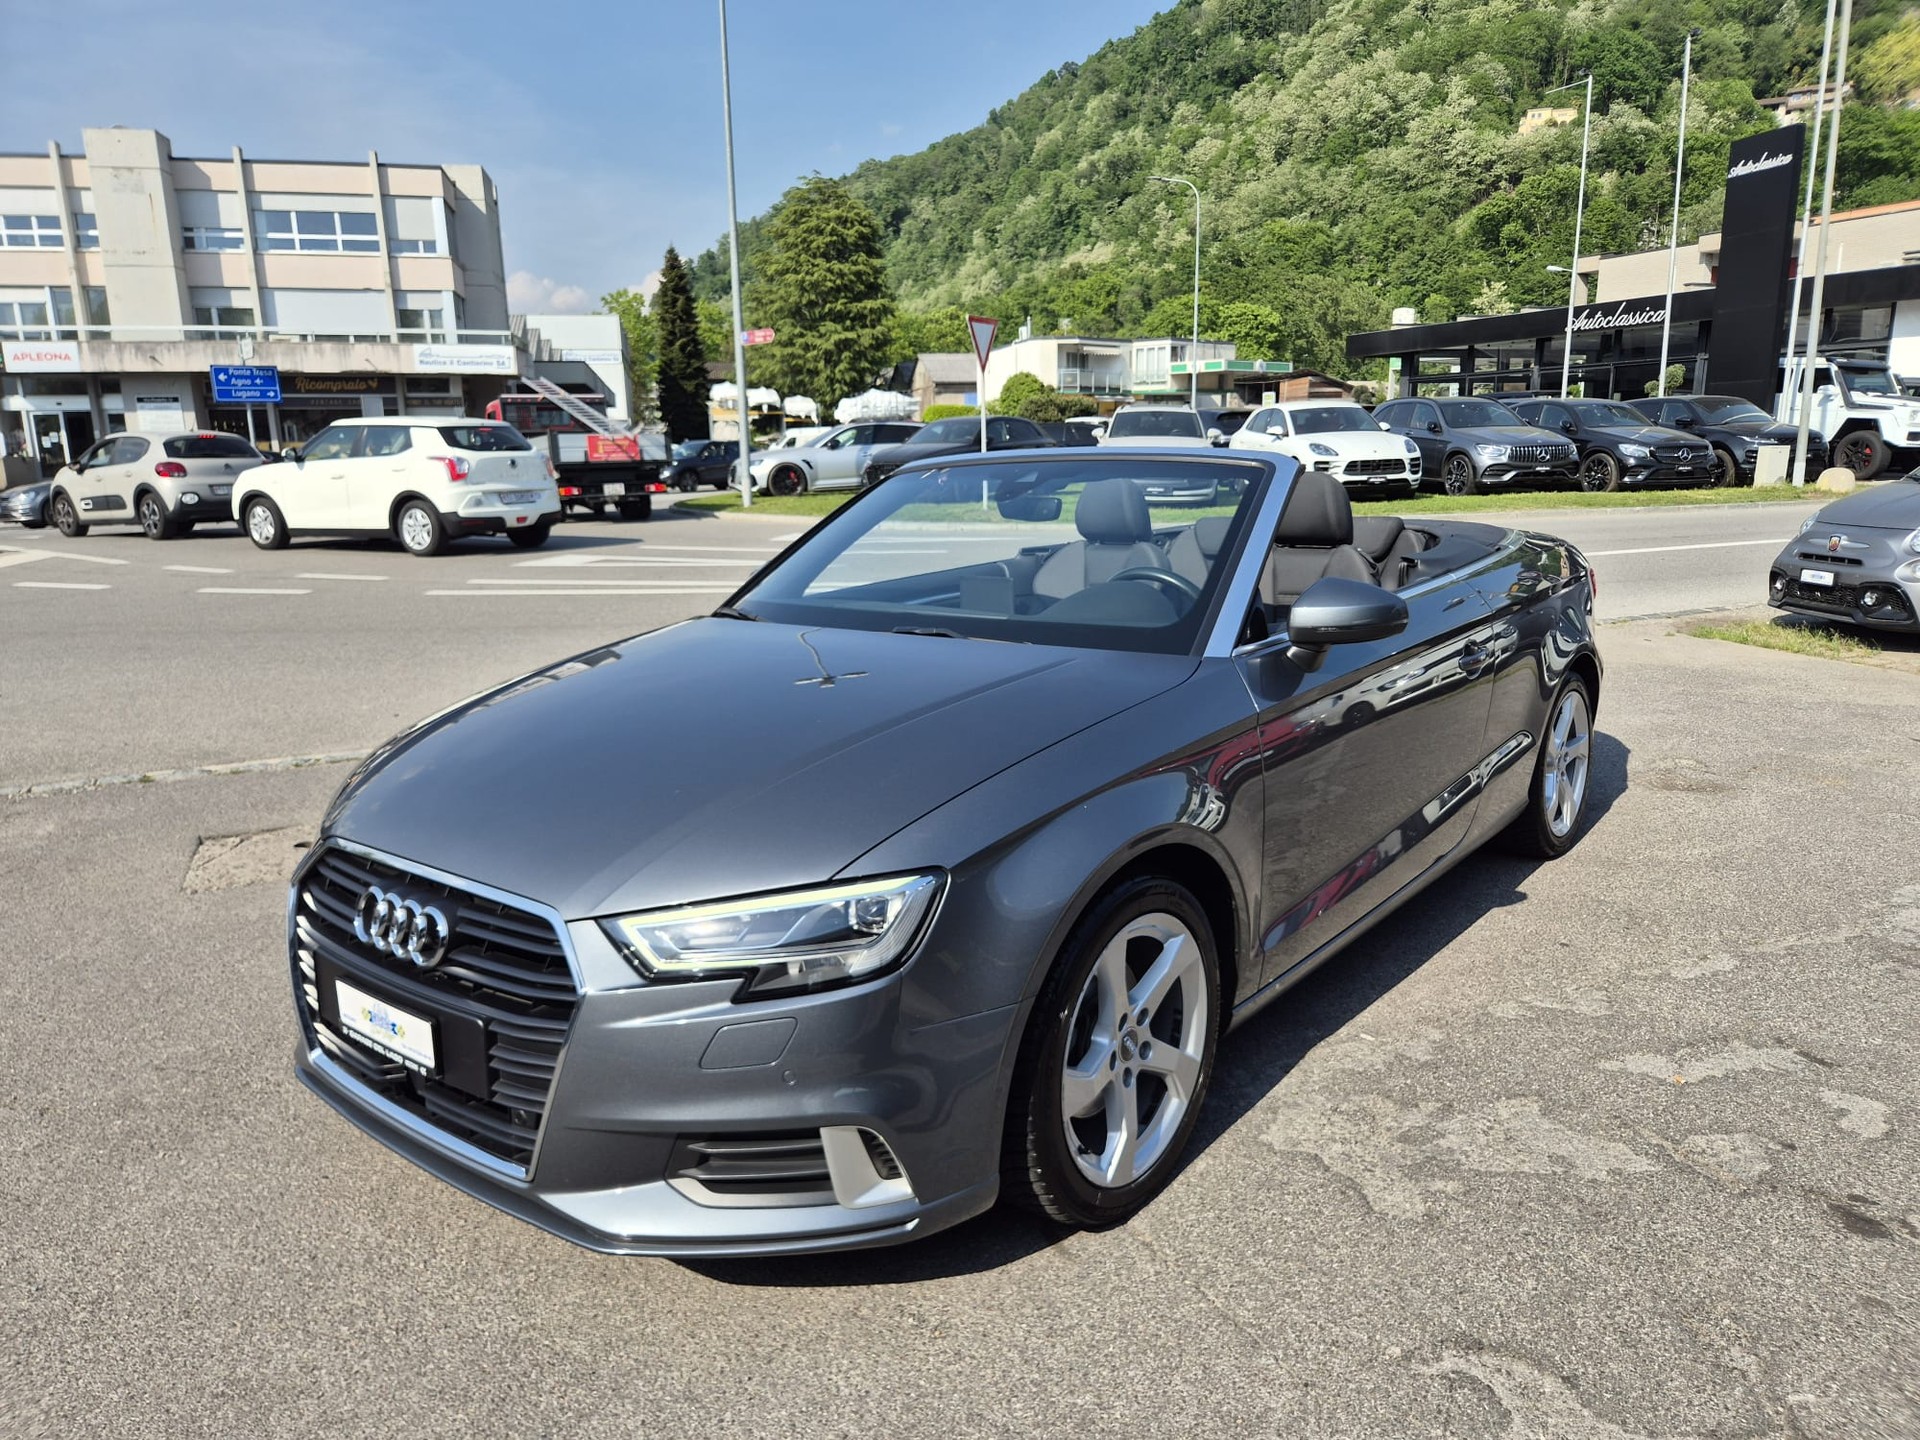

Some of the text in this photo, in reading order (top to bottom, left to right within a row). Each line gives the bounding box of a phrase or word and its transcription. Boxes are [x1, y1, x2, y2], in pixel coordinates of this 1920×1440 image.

[1564, 301, 1666, 332] Autoclassica
[12, 351, 72, 362] APLEONA
[228, 368, 273, 376] Ponte Tresa
[231, 377, 252, 387] Agno
[232, 388, 261, 399] Lugano
